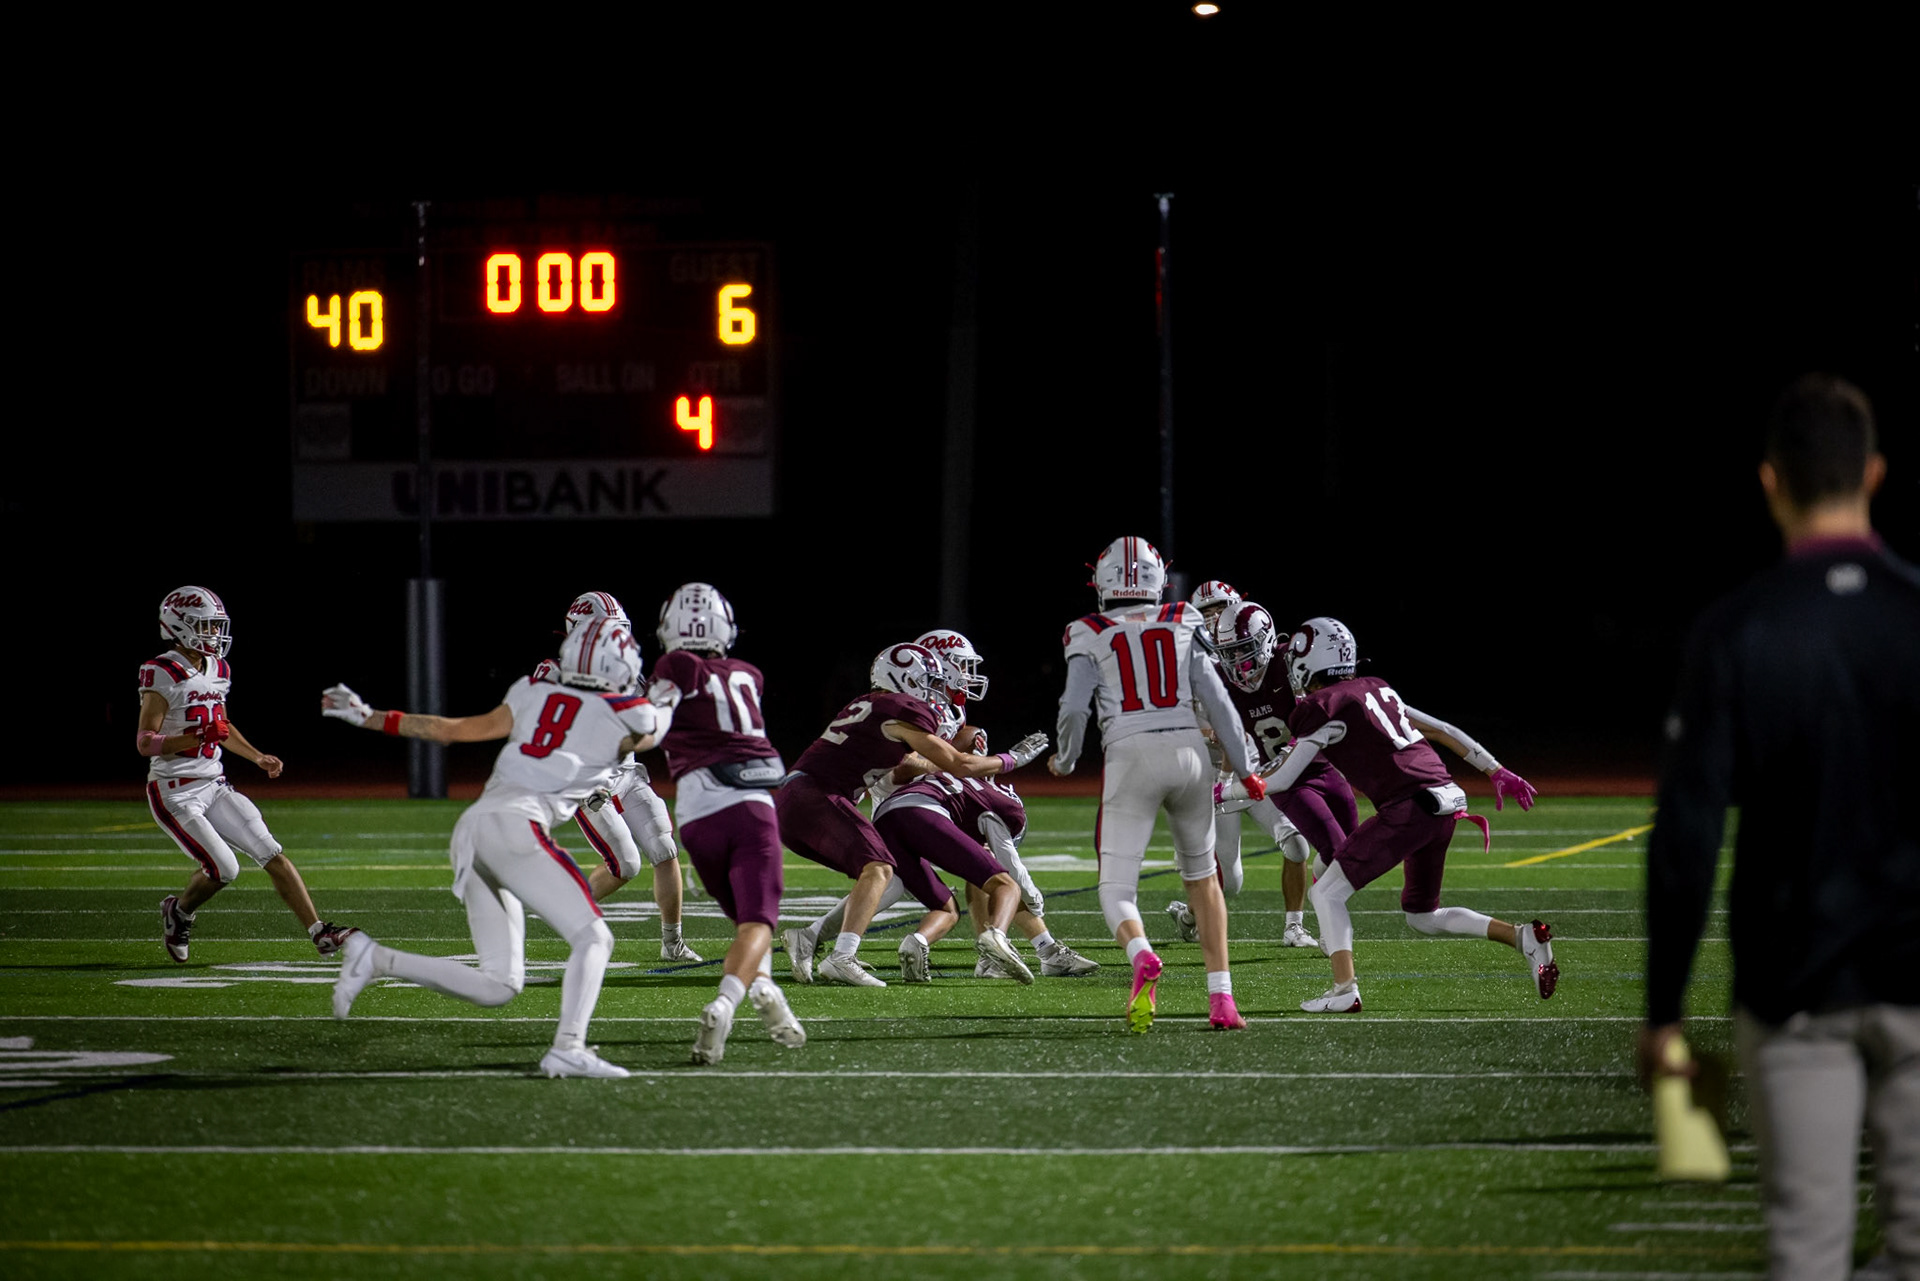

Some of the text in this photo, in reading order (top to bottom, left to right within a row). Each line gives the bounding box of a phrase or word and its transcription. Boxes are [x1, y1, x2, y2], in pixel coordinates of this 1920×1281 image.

[307, 291, 383, 350] 40
[718, 284, 756, 344] 6
[304, 366, 388, 397] DOWN
[676, 396, 712, 450] 4
[393, 471, 668, 513] UNIBANK
[164, 592, 203, 609] Pats
[1112, 589, 1148, 597] Riddell
[689, 623, 705, 638] 10
[919, 635, 966, 650] Pats
[1110, 628, 1180, 713] 10
[1339, 648, 1352, 662] 12
[520, 693, 583, 758] 8
[705, 671, 766, 738] 10
[1249, 704, 1273, 718] RAMS
[1365, 687, 1424, 750] 12
